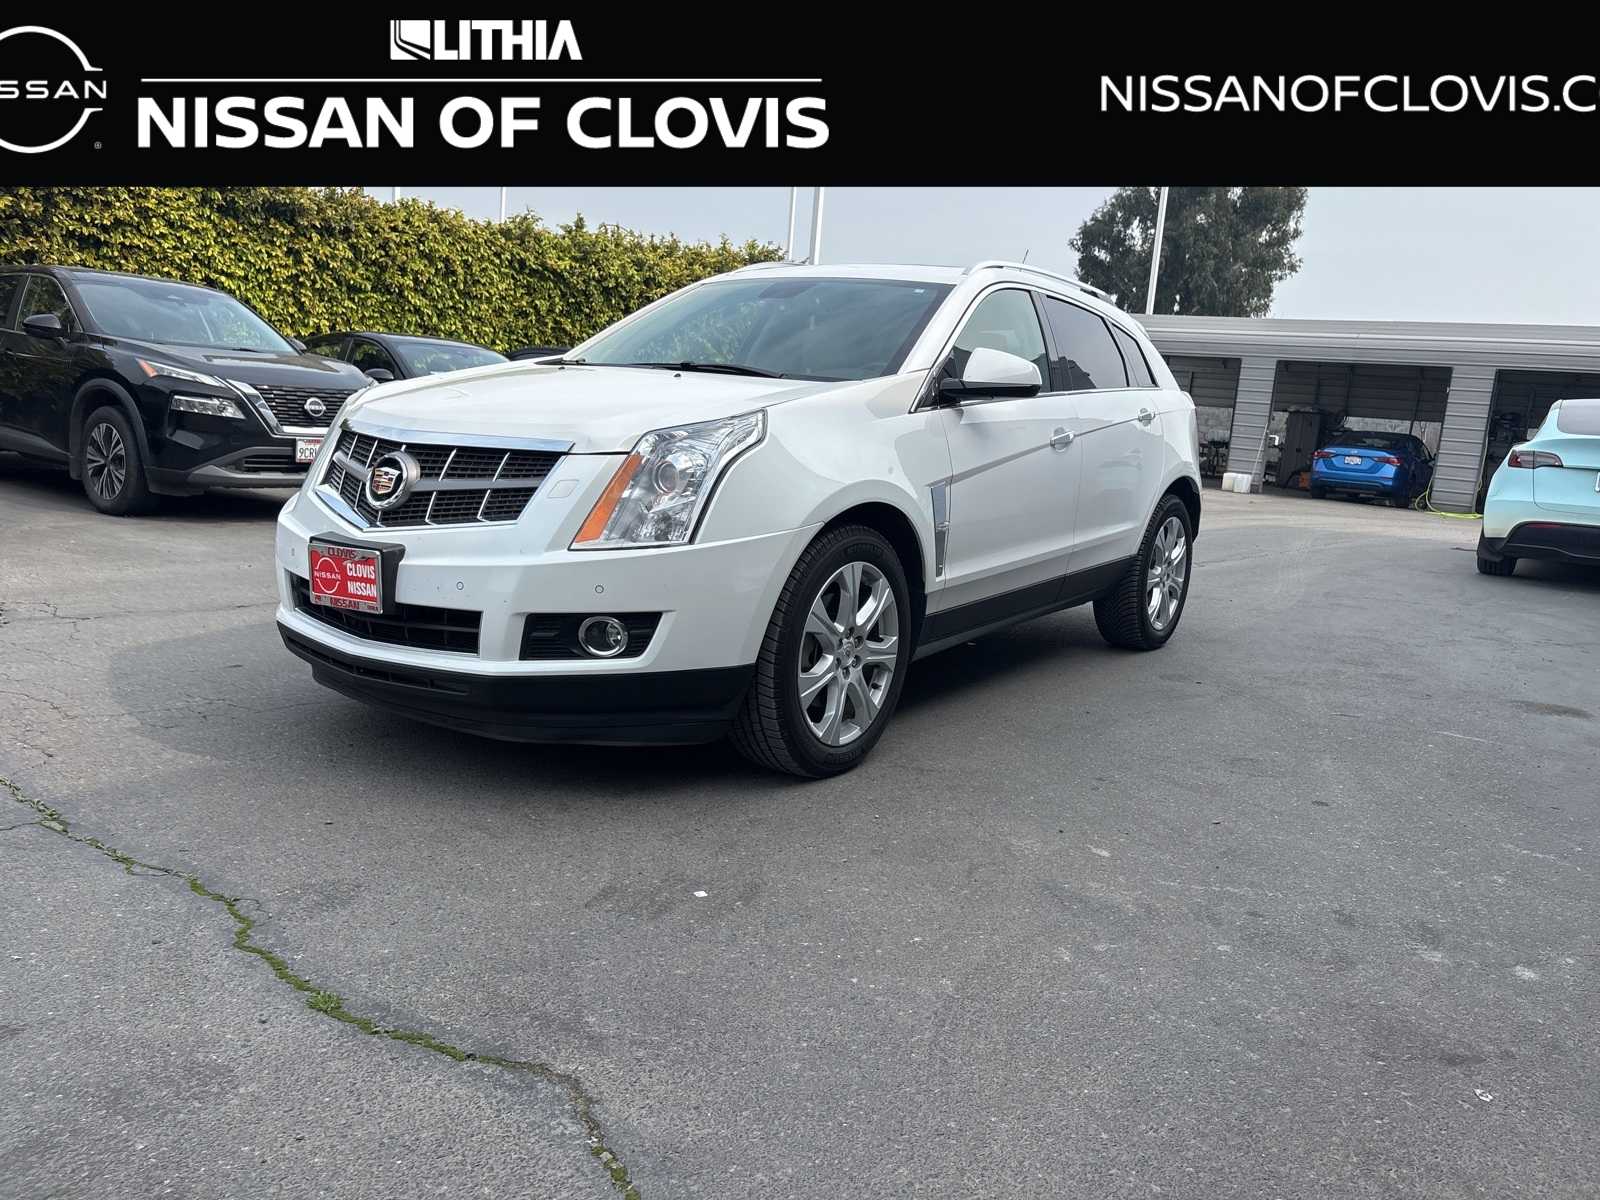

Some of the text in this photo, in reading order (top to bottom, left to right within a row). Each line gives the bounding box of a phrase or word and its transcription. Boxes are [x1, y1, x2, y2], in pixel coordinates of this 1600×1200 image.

[314, 571, 341, 580] NISSAN
[346, 563, 375, 579] CLOVIS
[347, 581, 377, 597] NISSAN
